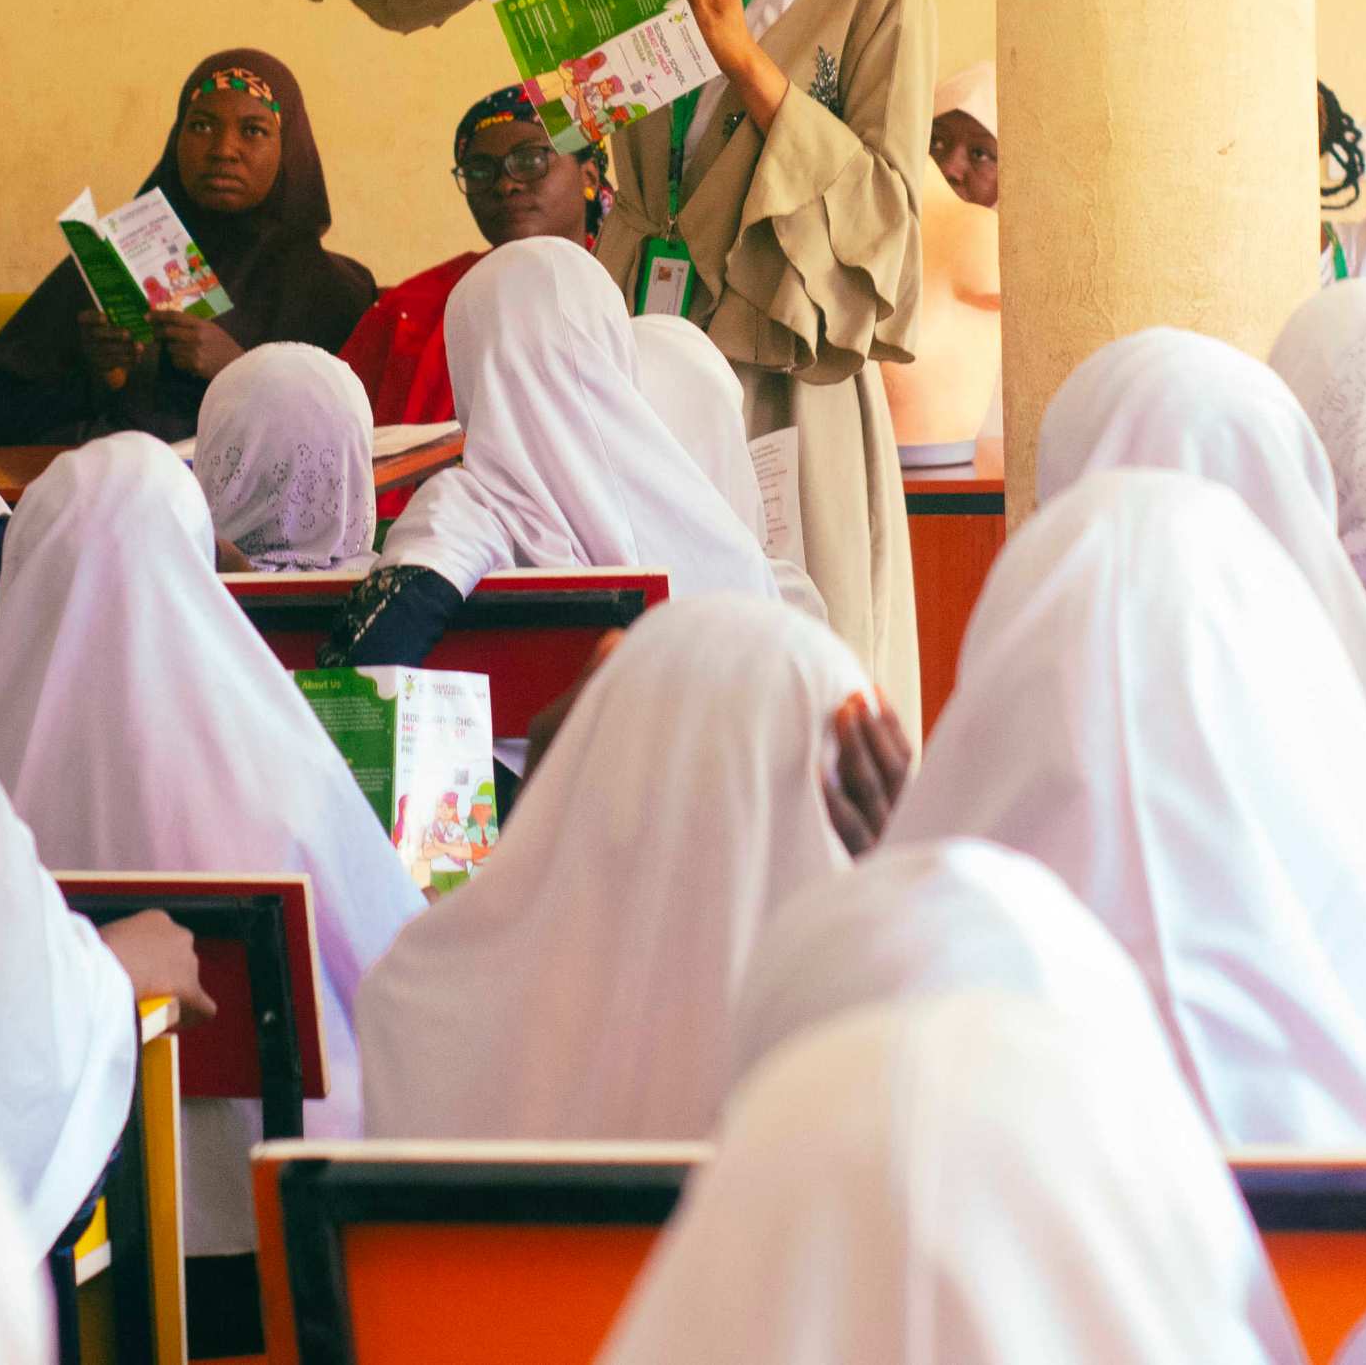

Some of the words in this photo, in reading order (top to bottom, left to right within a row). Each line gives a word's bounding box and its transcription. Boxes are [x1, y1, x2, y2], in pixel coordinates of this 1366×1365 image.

[652, 21, 673, 57] SECONDARY
[668, 57, 686, 85] SCHOOL
[654, 49, 672, 76] CANCER
